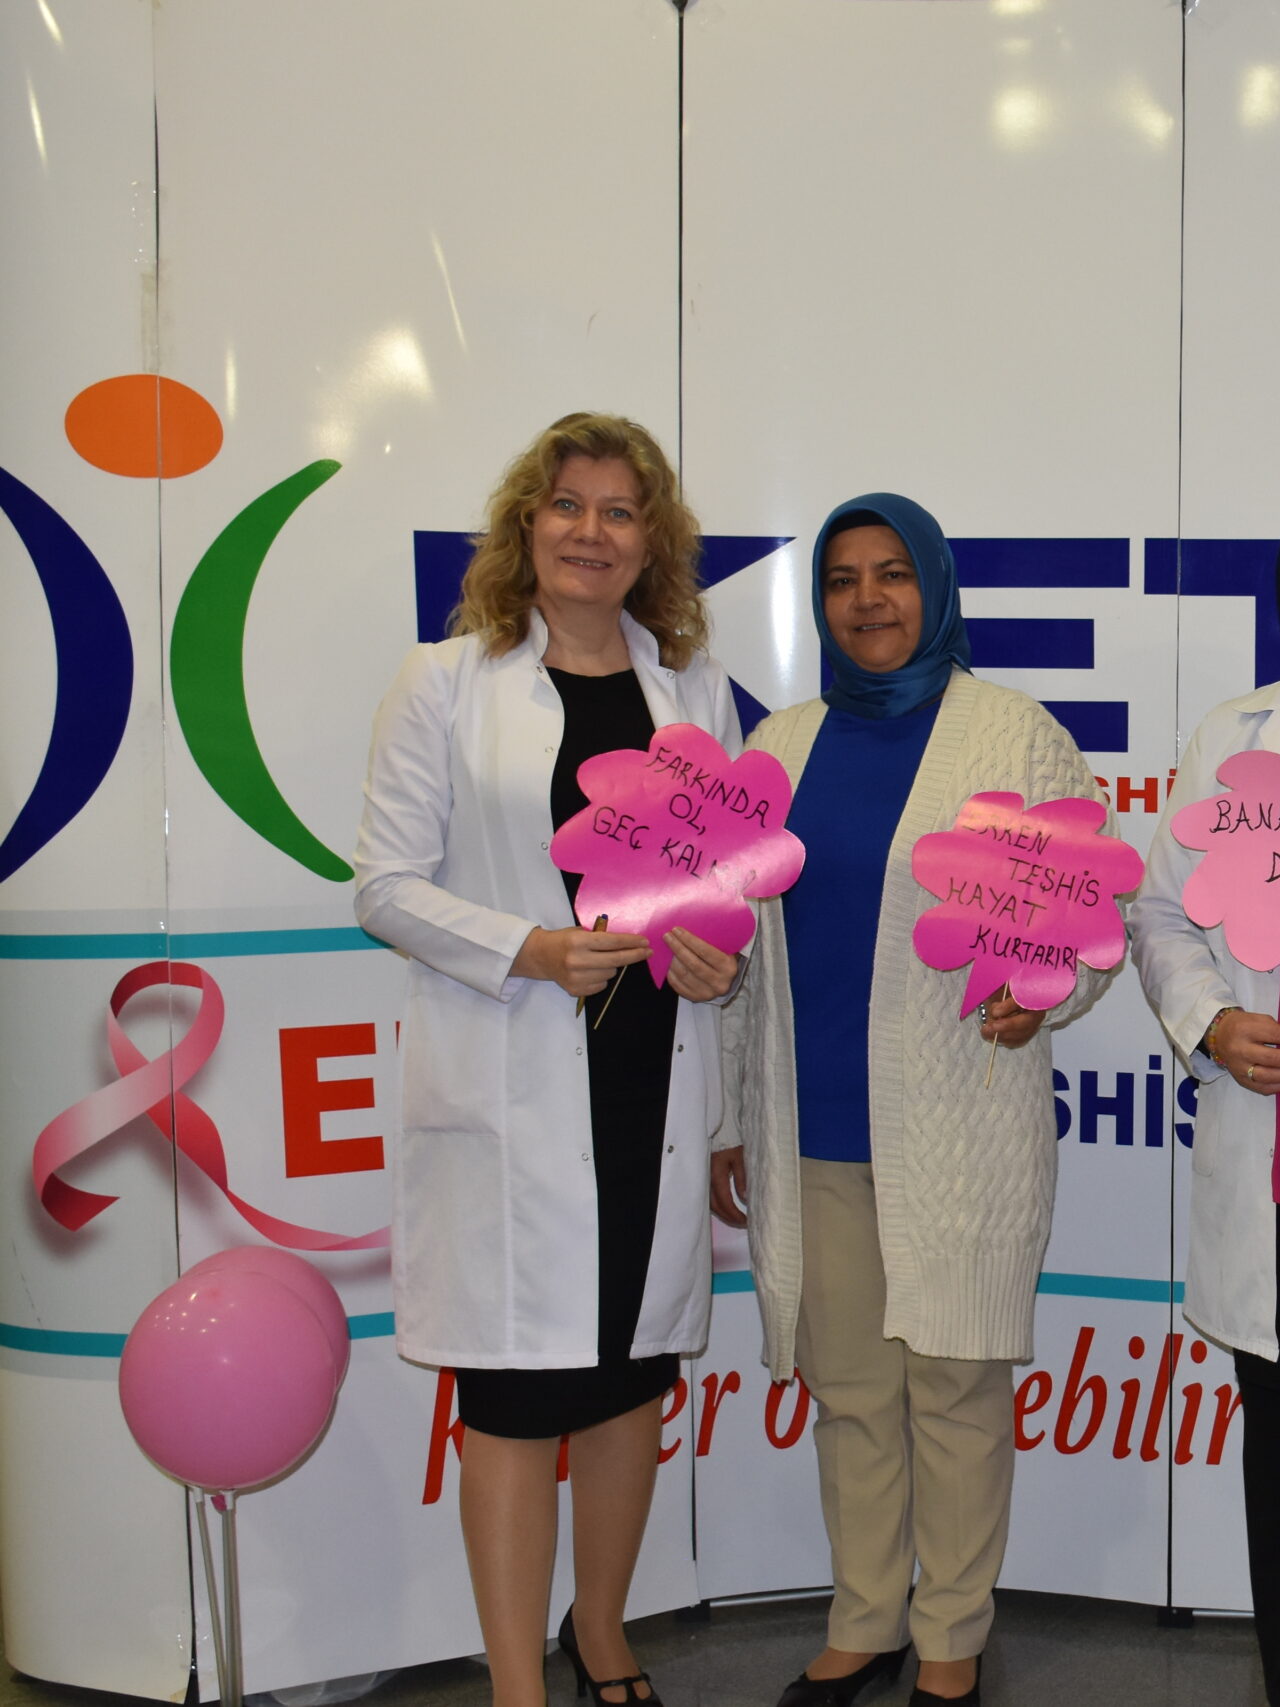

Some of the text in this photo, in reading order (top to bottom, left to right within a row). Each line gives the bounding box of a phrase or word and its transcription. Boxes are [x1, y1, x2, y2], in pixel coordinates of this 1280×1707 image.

[646, 747, 769, 828] FARKINDA
[593, 806, 649, 850] GEÇ
[669, 794, 706, 836] OL,
[947, 877, 1048, 927] HAYAT
[1008, 857, 1100, 907] TEŞHİS
[969, 924, 1078, 976] KURTARIR!
